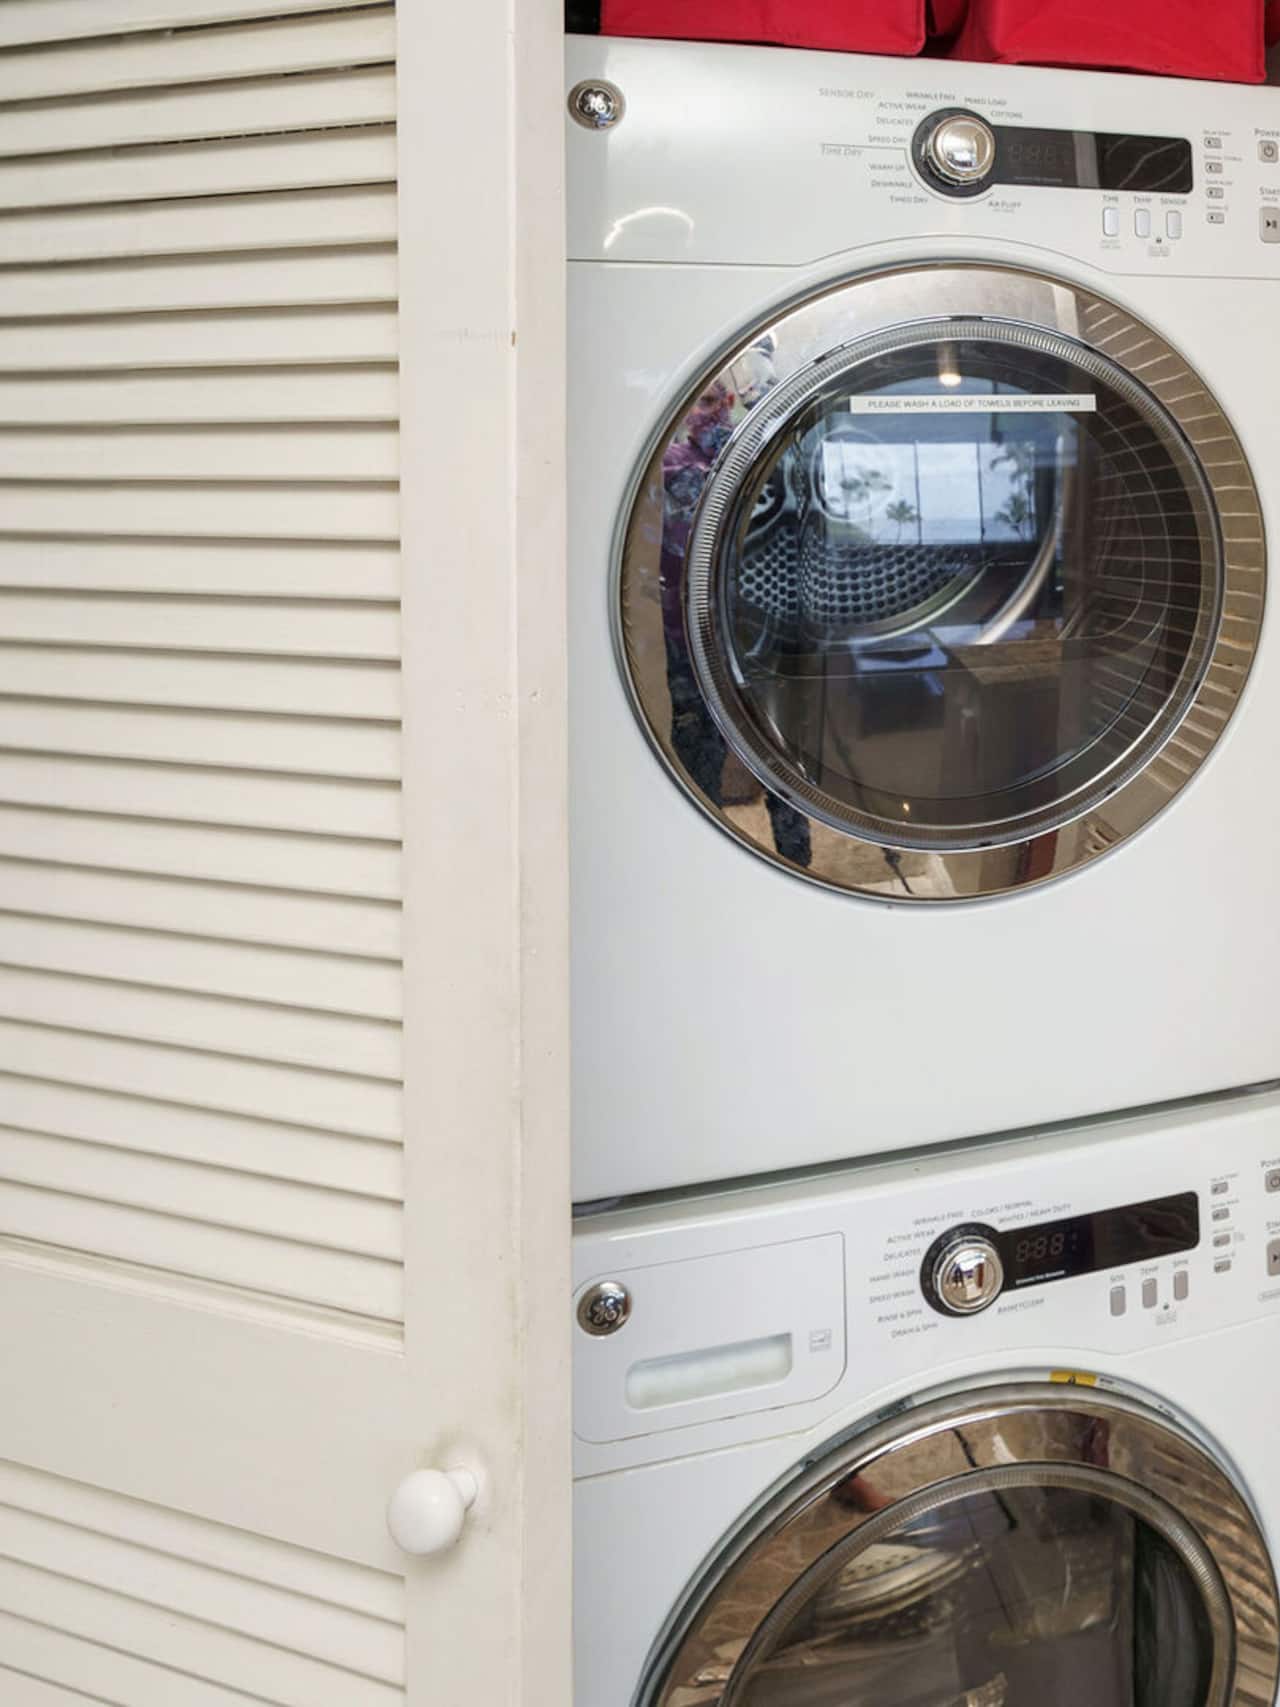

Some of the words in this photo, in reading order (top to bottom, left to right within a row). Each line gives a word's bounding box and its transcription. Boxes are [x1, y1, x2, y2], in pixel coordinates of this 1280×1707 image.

[819, 88, 855, 98] SENSOR
[856, 90, 875, 99] DRY
[879, 101, 903, 110] ACTIVE
[876, 116, 914, 126] DELICATES
[1254, 127, 1280, 137] POWER
[868, 134, 890, 143] SPEED
[843, 148, 862, 157] DRY
[1259, 186, 1280, 195] START
[868, 400, 901, 409] PLEASE
[903, 400, 929, 408] WASH
[931, 400, 937, 408] A
[939, 400, 961, 408] LOAD
[964, 400, 974, 408] OF
[978, 400, 1011, 408] TOWELS
[1013, 400, 1044, 408] BEFORE
[1048, 400, 1080, 408] LEAVING
[1053, 1203, 1072, 1213] DUTY
[887, 1233, 911, 1243] ACTIVE
[913, 1229, 935, 1238] WEAR
[883, 1248, 921, 1261] DELICATES
[893, 1269, 915, 1279] WASH
[869, 1293, 890, 1304] SPEED
[893, 1289, 915, 1298] WASH
